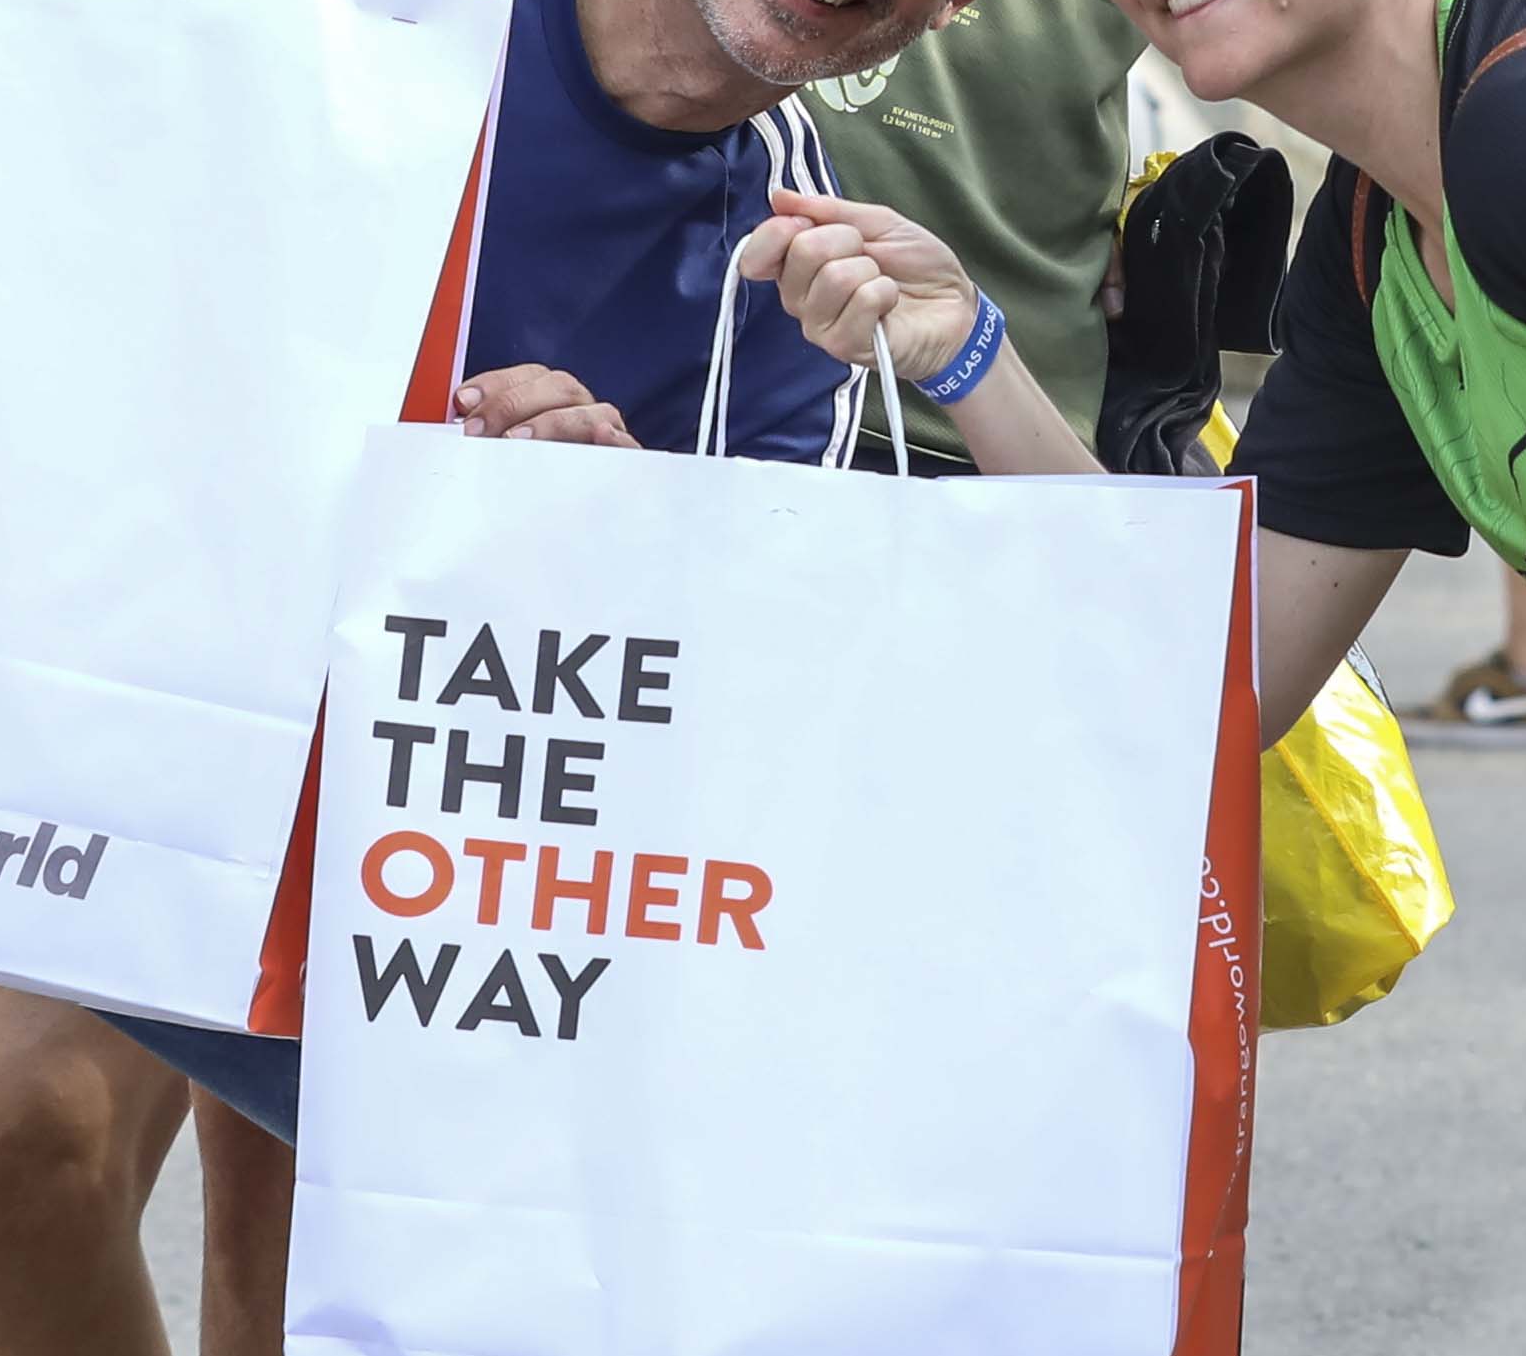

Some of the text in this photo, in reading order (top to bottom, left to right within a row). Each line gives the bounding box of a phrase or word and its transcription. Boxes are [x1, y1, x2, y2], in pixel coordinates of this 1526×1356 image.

[937, 305, 997, 395] DE LAS TUCAS
[384, 615, 680, 724] TAKE
[373, 721, 607, 827] THE
[361, 830, 773, 951] OTHER
[352, 933, 611, 1041] WAY
